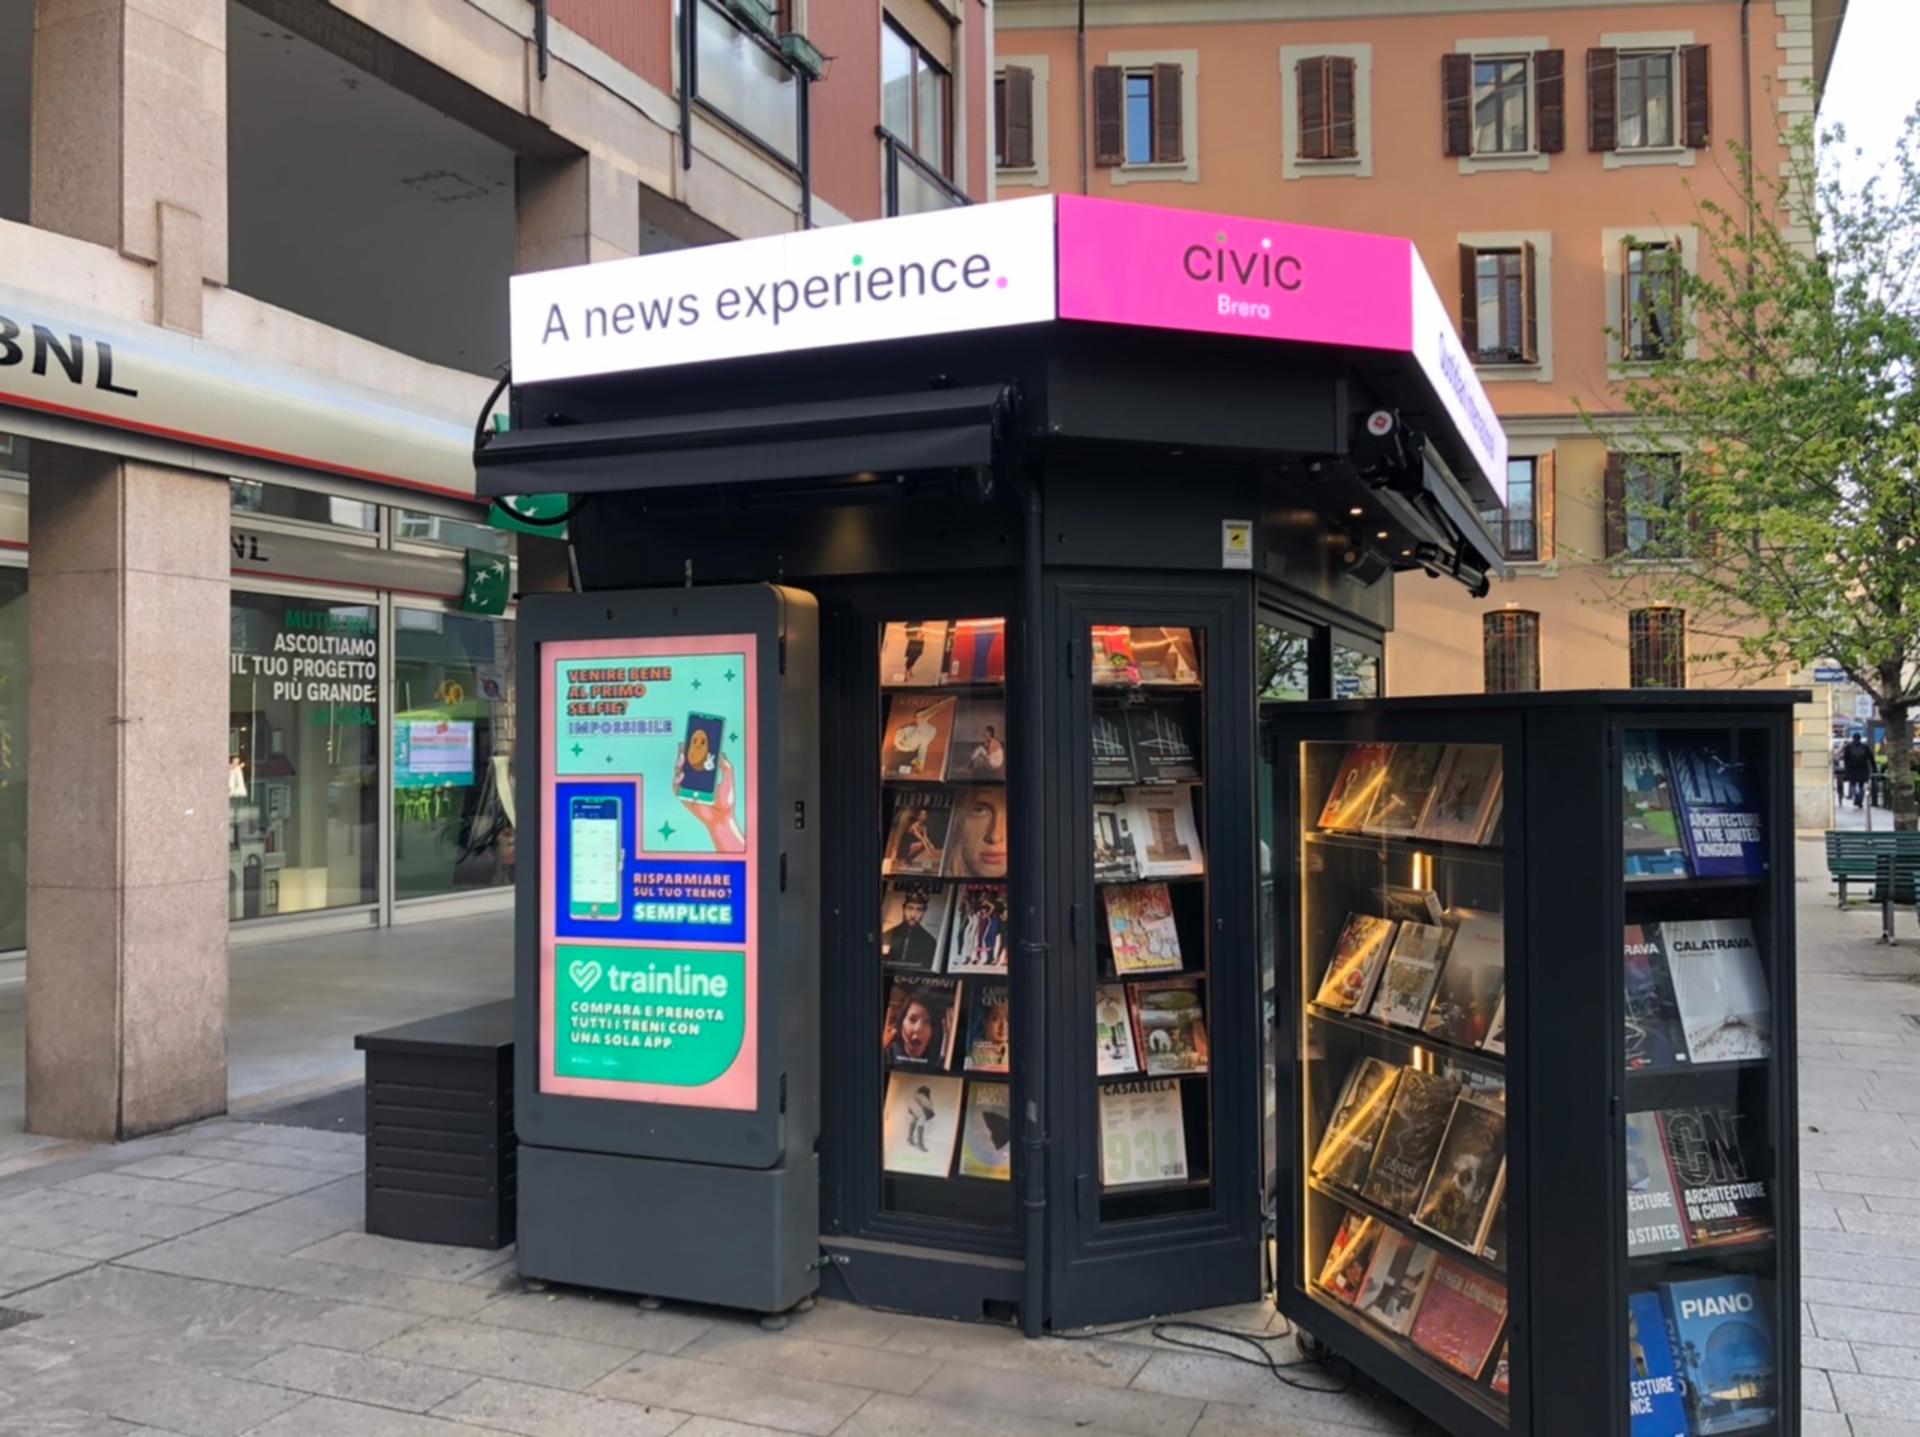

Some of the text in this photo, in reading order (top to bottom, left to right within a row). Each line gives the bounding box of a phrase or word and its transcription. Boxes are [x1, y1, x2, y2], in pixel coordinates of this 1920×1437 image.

[541, 252, 1009, 345] A news experience.
[1217, 294, 1271, 320] Brera
[274, 633, 376, 657] ASCOLTIAMO
[231, 653, 376, 680] IL TUO PROGETTO
[567, 666, 672, 683] VENIRE BENE
[274, 677, 302, 701] PIÙ
[567, 683, 646, 700] AL PRIMO
[567, 701, 628, 716] SELFIE?
[569, 719, 673, 735] IMPOSSIBILE
[1689, 813, 1761, 828] ARCHITECTURE
[1692, 828, 1760, 842] IN THE UNITED
[1696, 843, 1744, 857] KINGDOM
[633, 873, 731, 886] RISPARMIARE
[633, 887, 732, 898] SUL TUO TRENO?
[633, 902, 732, 924] SEMPLICE
[1673, 937, 1752, 952] CALATRAVA
[608, 963, 728, 998] trainline
[571, 1002, 724, 1021] COMPARA E PRENOTA
[571, 1017, 613, 1029] TUTTI
[623, 1019, 665, 1033] TRENI
[668, 1022, 700, 1035] CON
[571, 1032, 600, 1044] UNA
[604, 1033, 640, 1047] SOLA
[1103, 1081, 1177, 1096] CASABELLA
[1106, 1128, 1179, 1180] 931
[1668, 1109, 1748, 1185] CN
[1684, 1181, 1766, 1205] ARCHITECTURE
[1688, 1202, 1738, 1221] IN CHINA
[1636, 1224, 1680, 1243] STATES
[1681, 1292, 1754, 1320] PIANO
